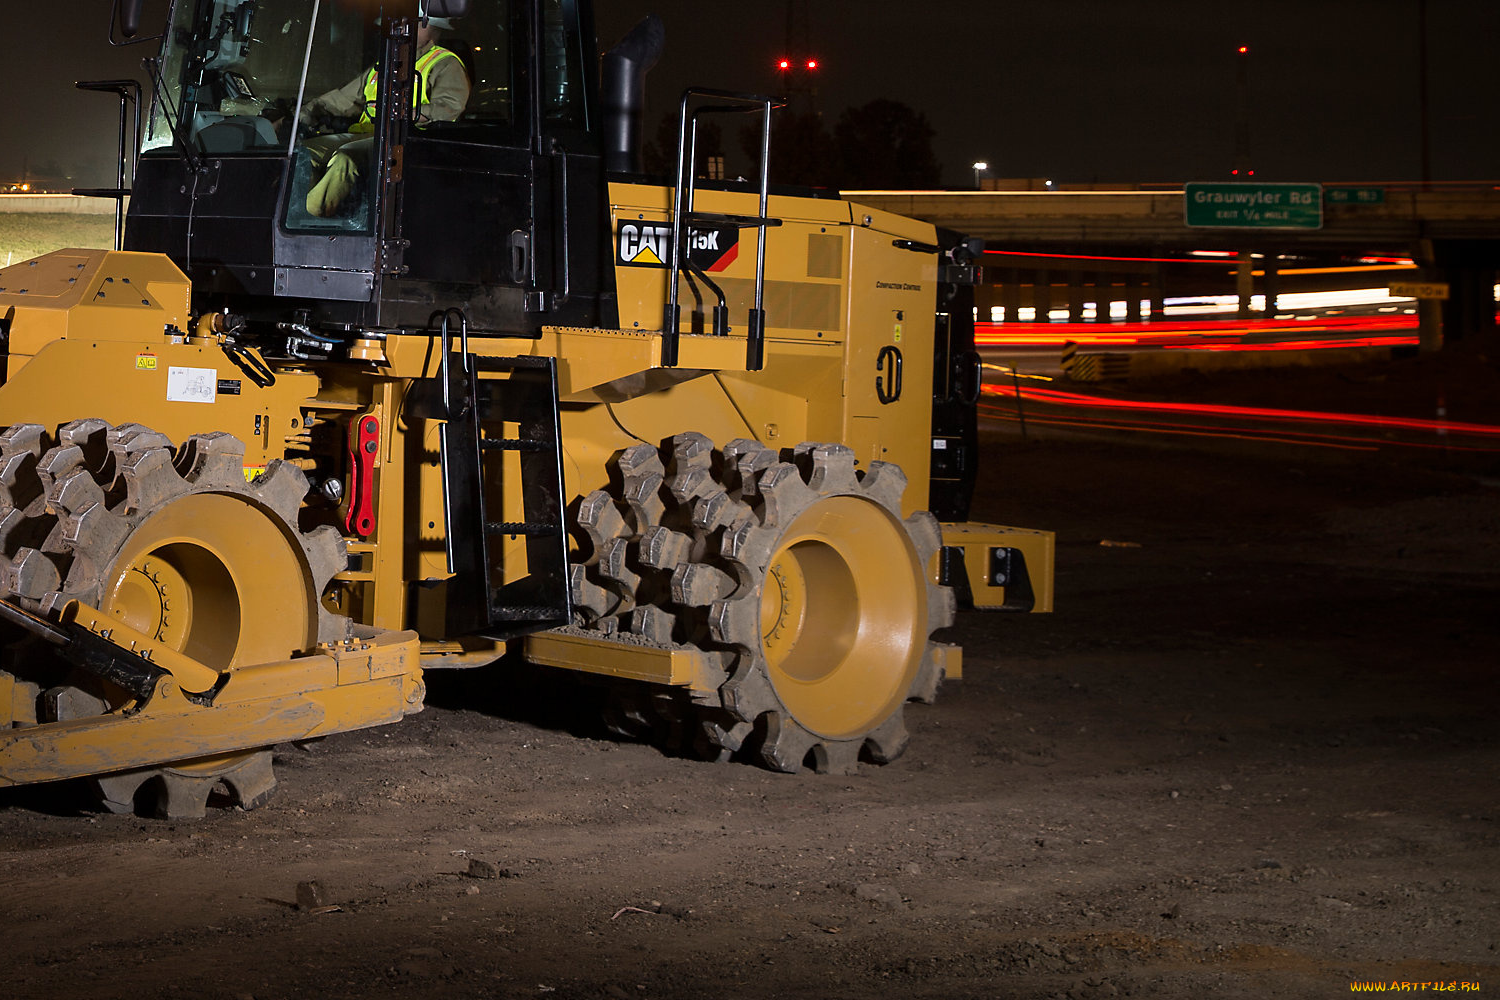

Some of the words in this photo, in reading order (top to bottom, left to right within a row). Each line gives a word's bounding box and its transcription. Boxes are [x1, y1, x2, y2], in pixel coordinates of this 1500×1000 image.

[1194, 190, 1282, 207] Grauwyler
[1289, 191, 1312, 204] Rd
[1216, 210, 1238, 219] EXIT
[620, 224, 672, 264] CAT
[690, 229, 720, 251] 15K
